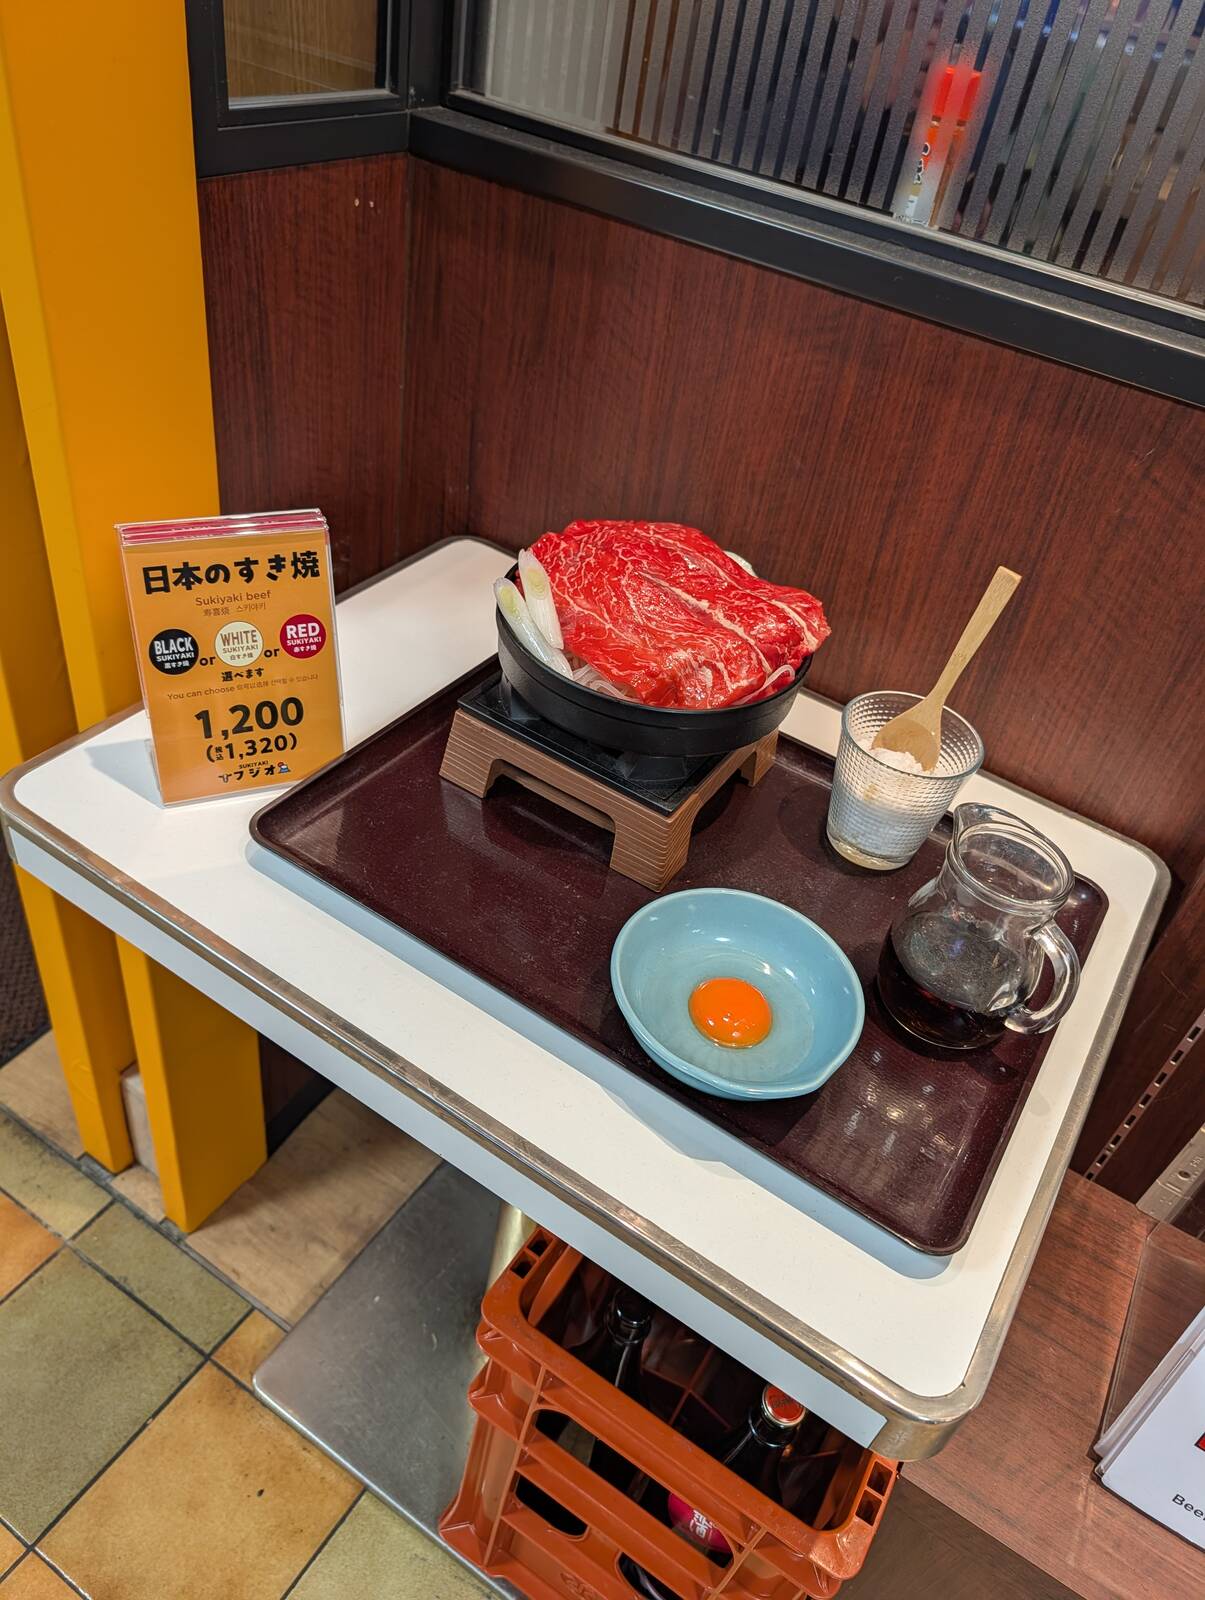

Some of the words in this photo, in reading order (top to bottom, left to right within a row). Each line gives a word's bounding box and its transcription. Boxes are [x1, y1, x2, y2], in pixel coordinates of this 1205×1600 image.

[142, 550, 320, 595] 日本のすき焼
[195, 593, 243, 606] Sukiyaki
[246, 590, 271, 601] beef
[220, 629, 258, 647] WHITE
[286, 622, 320, 639] RED
[154, 636, 194, 655] BLACK
[287, 636, 322, 646] SUKIYAKI
[222, 644, 259, 654] SUKIYAKI
[264, 648, 280, 658] or
[156, 652, 195, 662] SUKIYAKI
[199, 655, 216, 666] or
[221, 667, 264, 682] 選べます
[167, 692, 185, 701] You
[186, 690, 203, 698] can
[204, 686, 235, 696] choose
[194, 697, 304, 740] 1,200
[233, 764, 276, 780] フジオ
[238, 760, 269, 769] SUKIYAKI
[1172, 1493, 1205, 1521] Bee
